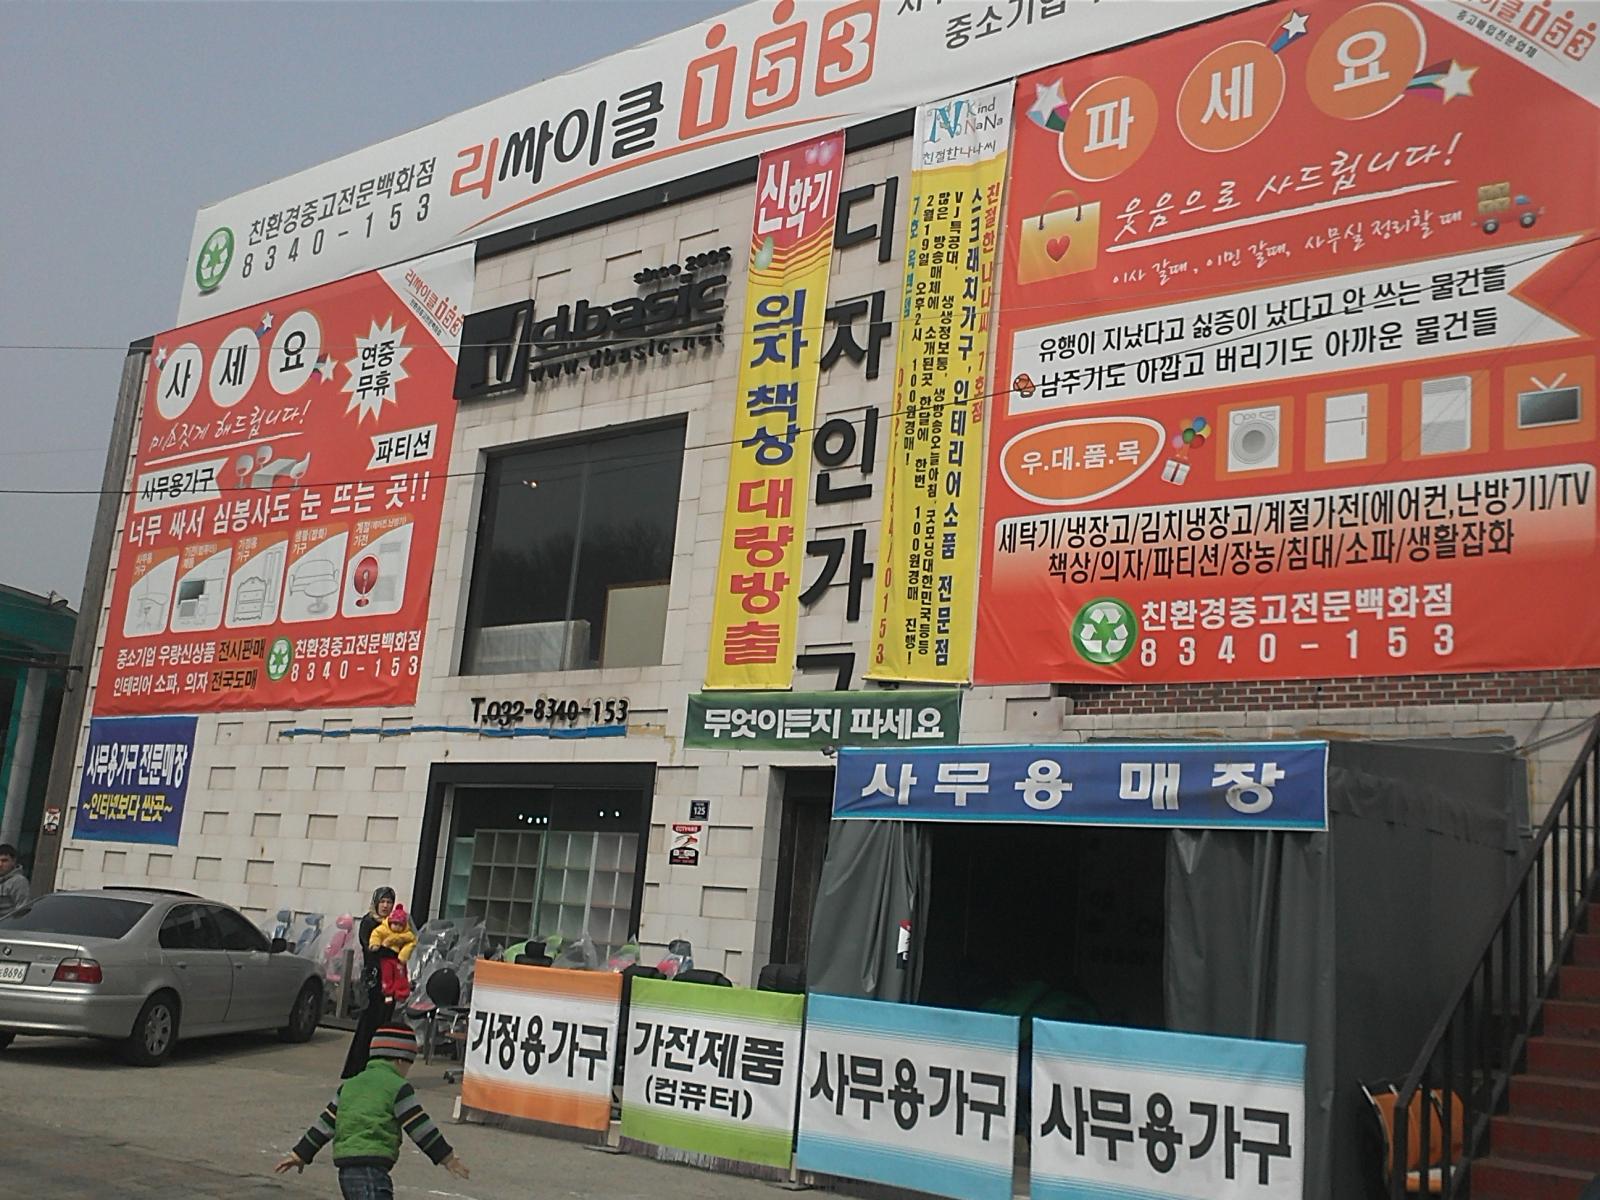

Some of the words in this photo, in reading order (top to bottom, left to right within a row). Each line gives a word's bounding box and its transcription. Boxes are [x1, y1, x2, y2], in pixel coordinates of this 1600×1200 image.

[449, 80, 664, 201] 리싸이클
[248, 157, 437, 246] 친환경중고전문백화점
[758, 160, 832, 238] 신학기
[1115, 181, 1240, 241] 웃음으로
[1257, 132, 1462, 195] 사드립니다!
[1112, 269, 1145, 284] 이사
[1206, 248, 1241, 268] 이민
[1305, 222, 1366, 254] 사무실
[1371, 209, 1434, 239] 정리할
[1439, 210, 1462, 225] 때
[1039, 331, 1095, 363] 유행이
[1103, 317, 1185, 351] 지났다고
[1192, 305, 1257, 338] 싫증이
[1266, 293, 1333, 327] 났다고
[1343, 287, 1366, 315] 안
[1373, 280, 1421, 308] 쓰는
[1431, 264, 1506, 301] 물건들
[361, 340, 395, 369] 연중
[1040, 363, 1126, 398] 남주기도
[1137, 352, 1205, 384] 아깝고
[1216, 335, 1313, 373] 버리기도
[1325, 321, 1402, 358] 아까운
[1415, 307, 1498, 346] 물건들
[356, 371, 390, 400] 무휴
[375, 430, 430, 462] 파티션
[915, 458, 927, 488] 한번
[128, 515, 162, 547] 너무
[169, 506, 205, 540] 싸서
[213, 493, 291, 535] 심봉사도
[299, 489, 322, 521] 눈
[331, 480, 375, 514] 뜨는
[141, 468, 215, 502] 사무용가구
[935, 575, 953, 666] 전문점
[1141, 583, 1453, 632] 친환경중고전문백화점
[116, 646, 156, 671] 중소기업
[294, 629, 421, 659] 친환경중고전문백화점
[184, 671, 208, 693] 의자
[704, 708, 841, 740] 무엇이든지
[851, 707, 945, 740] 파세요
[138, 743, 188, 789] 전문매장
[861, 759, 1073, 811] 사무용
[1119, 761, 1286, 814] 매장
[472, 1011, 608, 1081] 가정용가구
[633, 1022, 785, 1086] 가전제품
[646, 1075, 753, 1120] (컴퓨터)
[809, 1051, 1006, 1141] 사무용가구
[1041, 1082, 1292, 1186] 사무용가구
